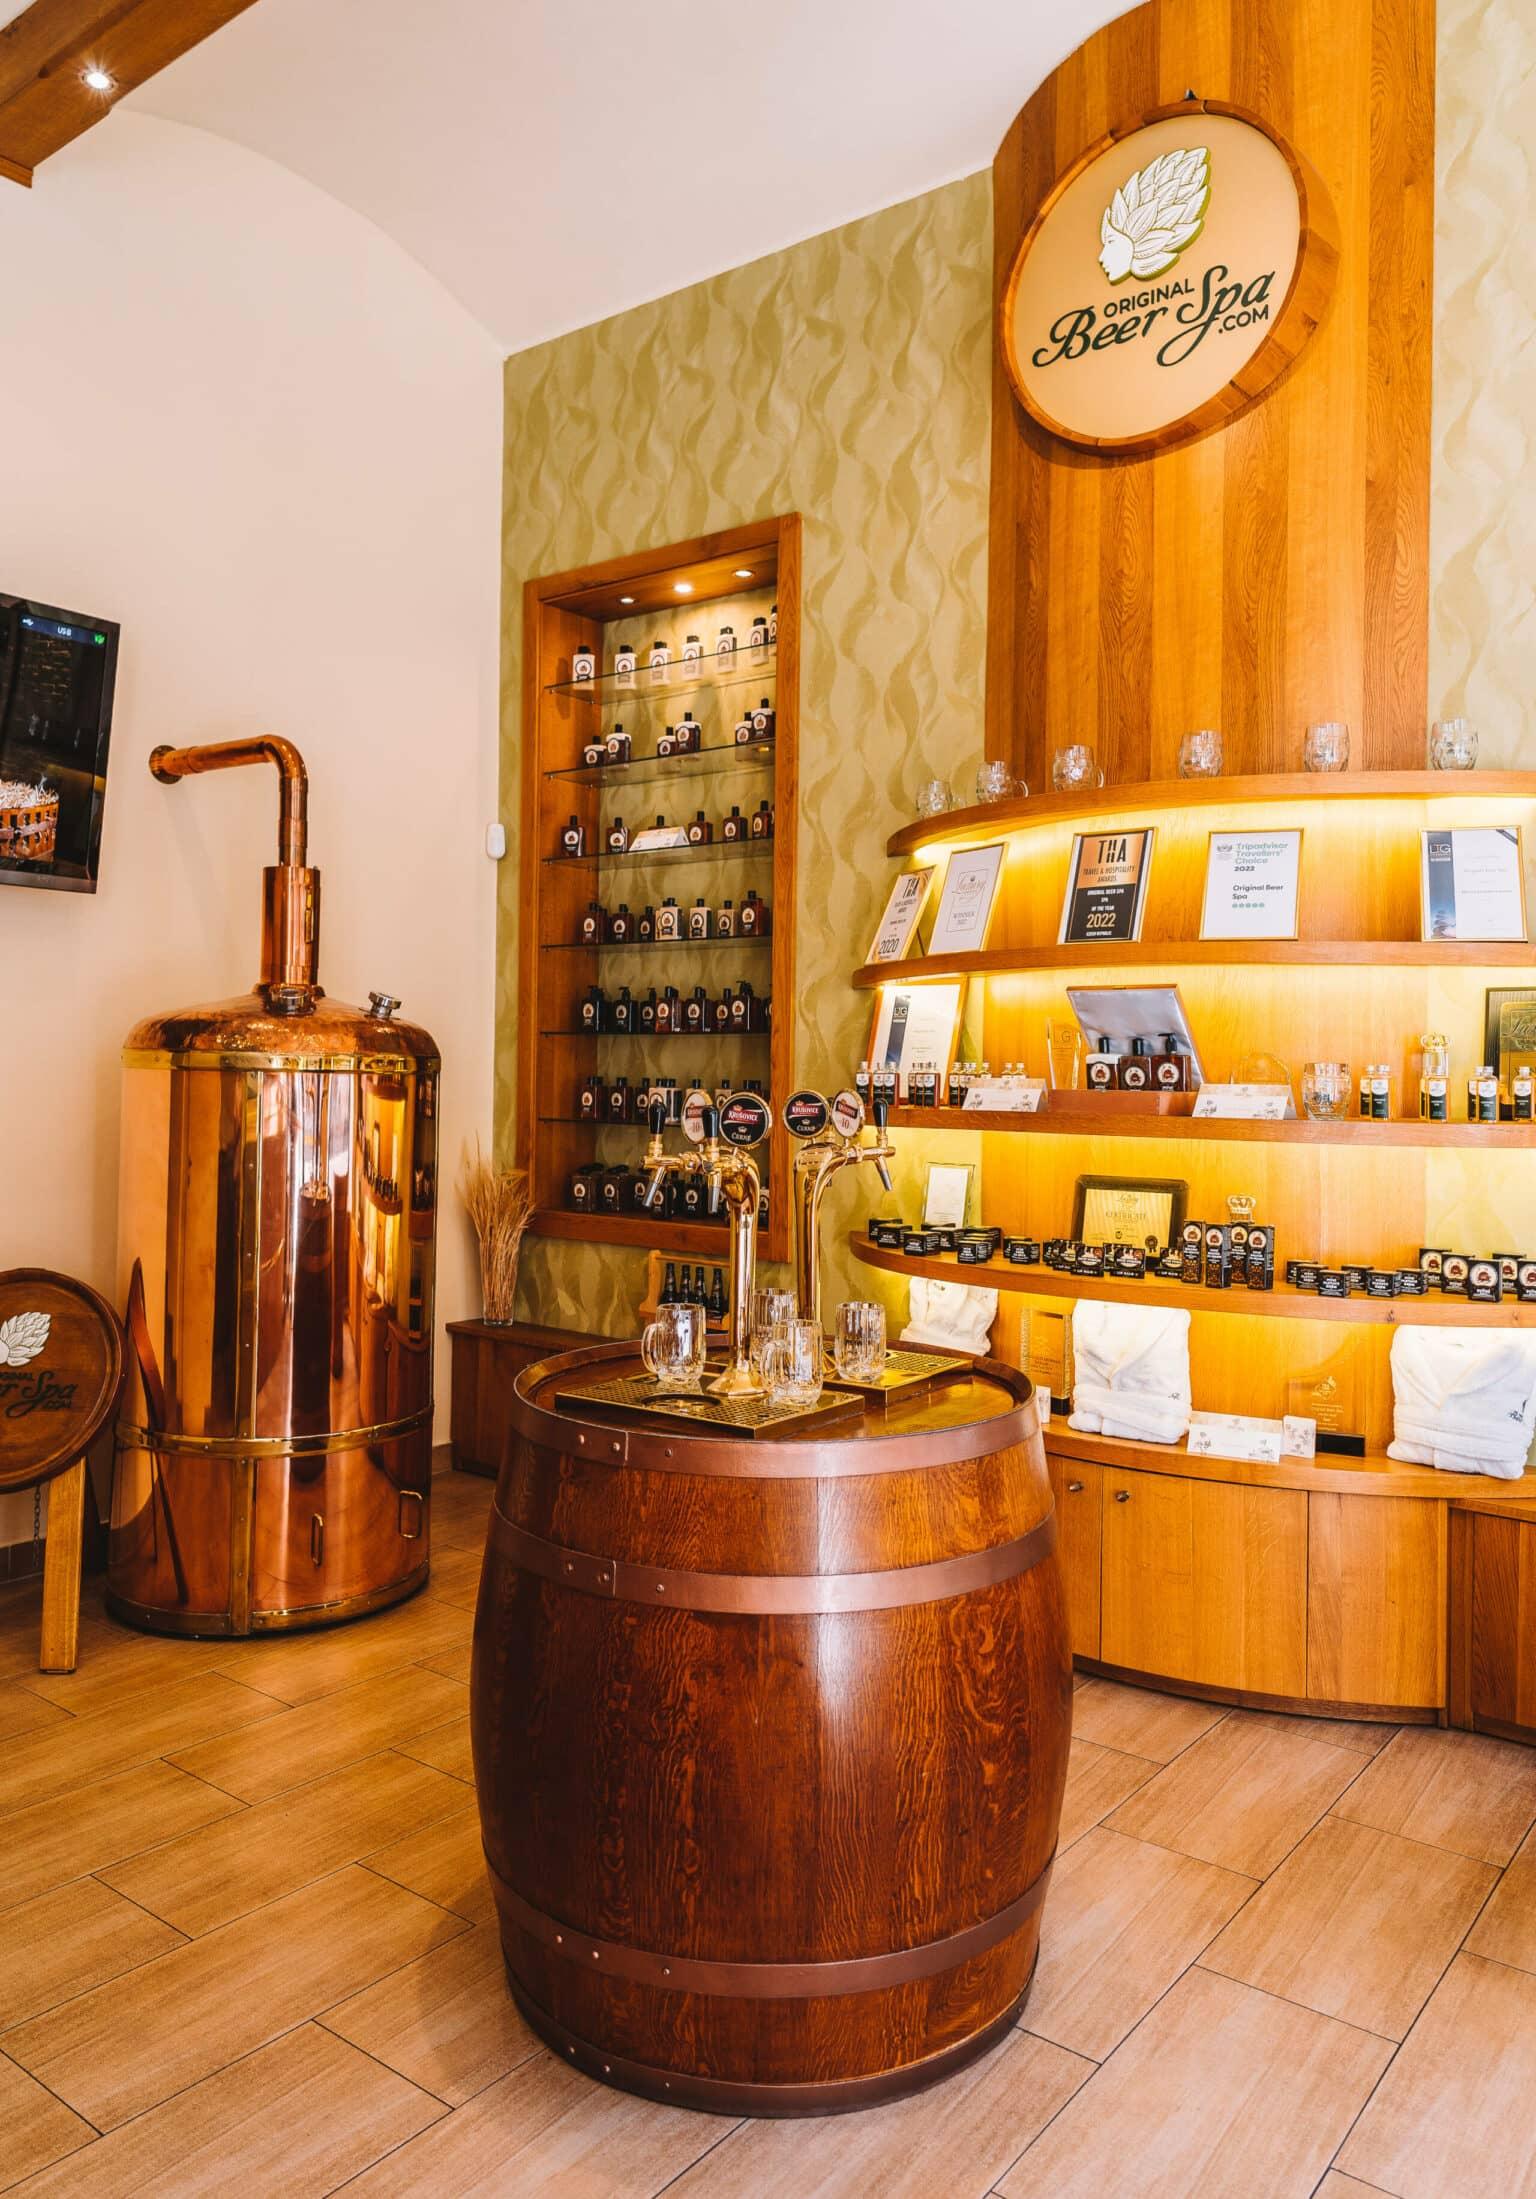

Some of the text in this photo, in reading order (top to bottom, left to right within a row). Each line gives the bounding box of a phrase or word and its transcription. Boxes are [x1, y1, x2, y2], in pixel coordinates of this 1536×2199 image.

[1104, 278, 1195, 318] ORIGINAL
[1032, 264, 1276, 367] Beer Spa
[1218, 304, 1269, 334] .COM
[57, 625, 72, 637] USB
[1236, 842, 1289, 851] Tripadvisor
[1235, 857, 1269, 865] Choice
[1232, 884, 1265, 892] Original
[1232, 893, 1248, 901] Spa
[1086, 912, 1117, 929] 2022
[878, 938, 901, 955] 2020
[5, 1370, 79, 1418] Spa
